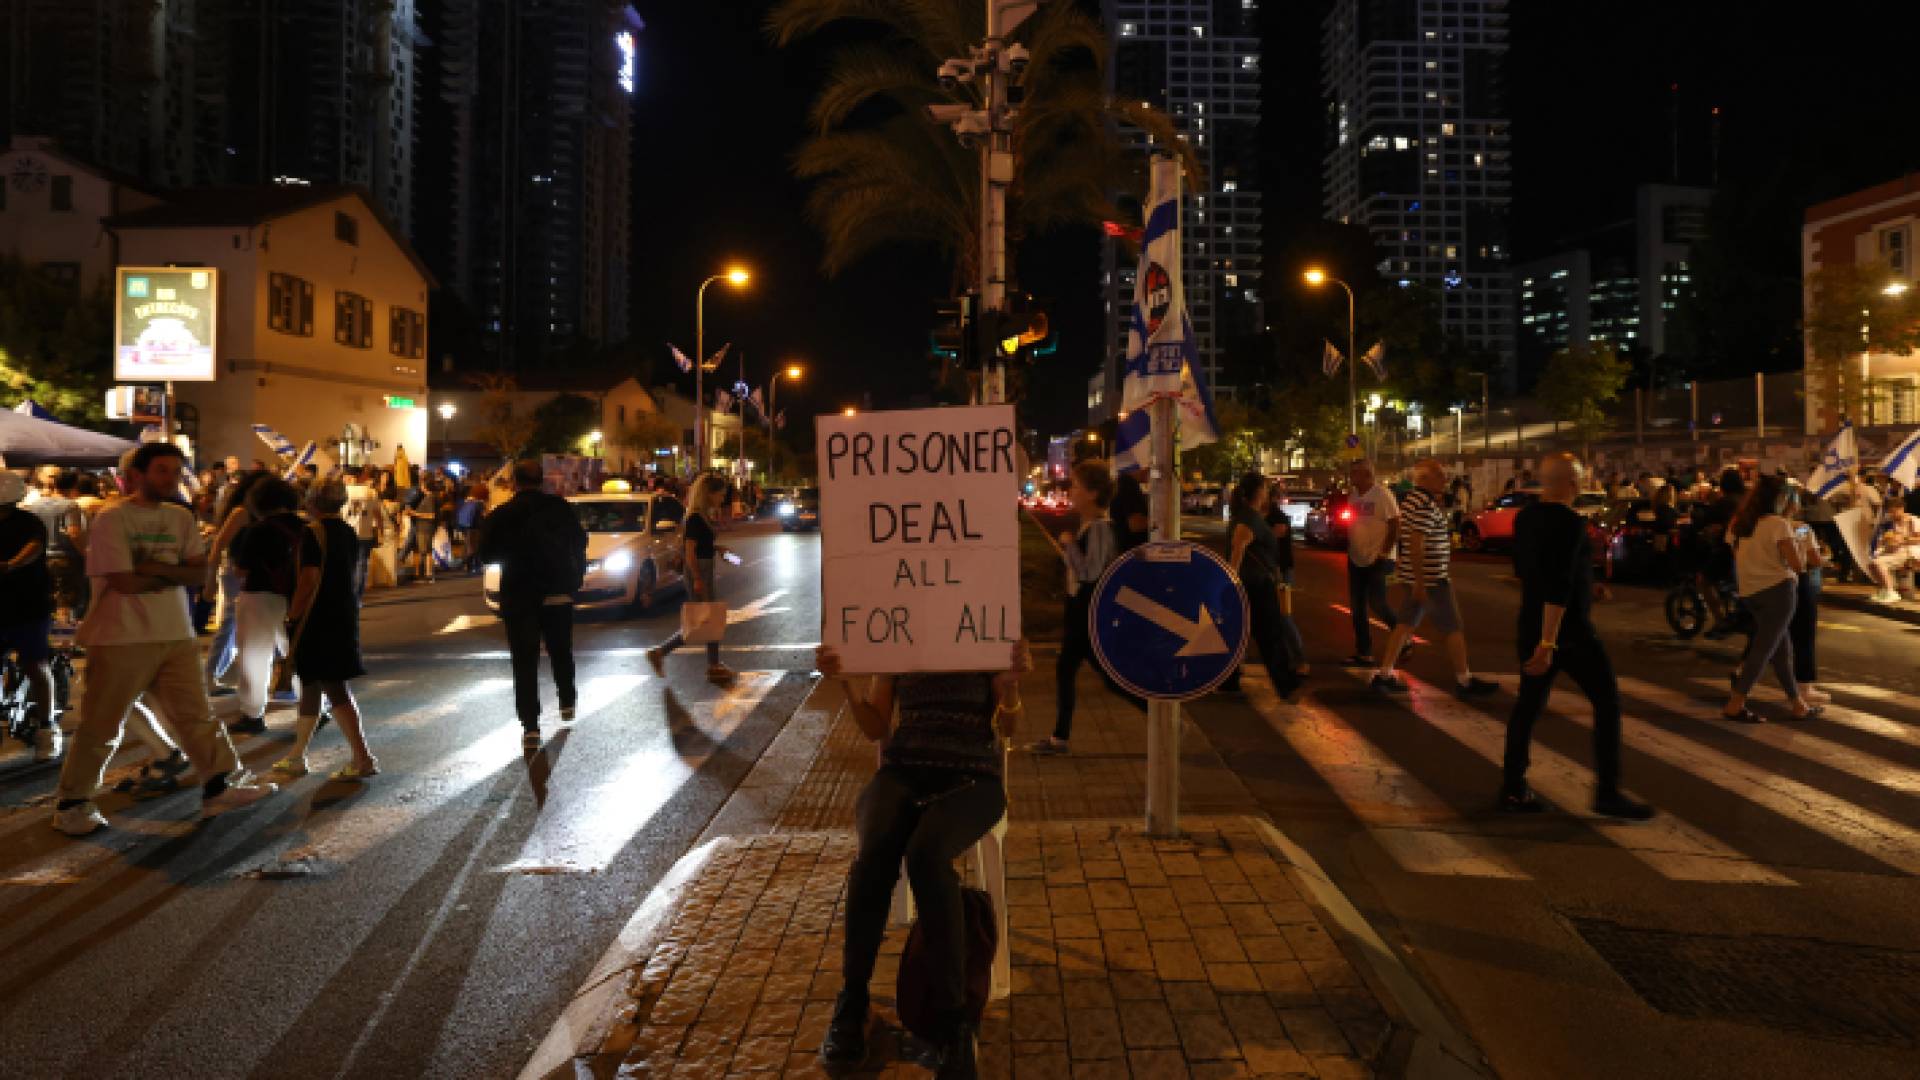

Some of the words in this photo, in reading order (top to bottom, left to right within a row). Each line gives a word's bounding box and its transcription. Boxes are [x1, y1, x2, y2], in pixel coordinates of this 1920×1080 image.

[826, 427, 1014, 480] PRISONER
[869, 499, 983, 544] DEAL
[894, 558, 962, 588] ALL
[841, 604, 914, 645] FOR
[955, 601, 1018, 644] ALL
